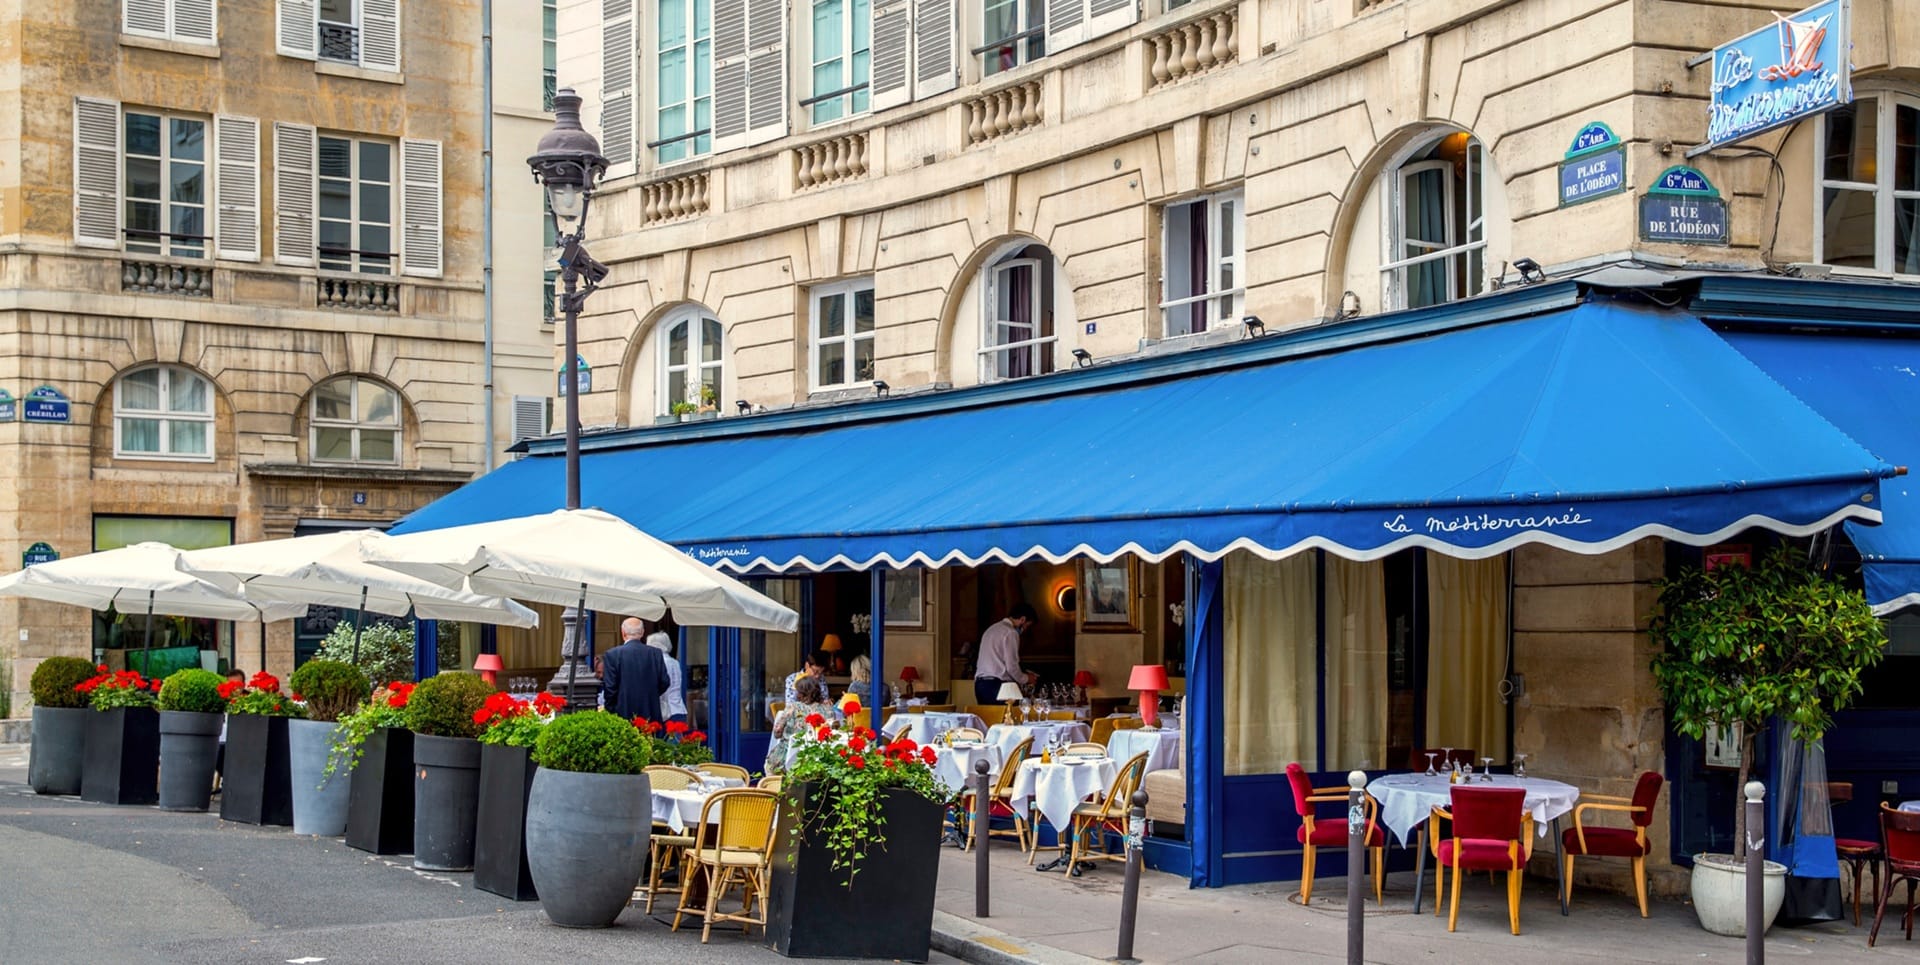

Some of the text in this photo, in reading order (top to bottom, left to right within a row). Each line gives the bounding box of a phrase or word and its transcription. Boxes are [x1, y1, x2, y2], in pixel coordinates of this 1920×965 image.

[1710, 47, 1753, 92] La
[1577, 160, 1607, 179] PLACE
[1566, 172, 1618, 197] DE L'ODÉON
[1670, 206, 1698, 219] RUE
[1649, 219, 1720, 235] DE L'ODÉON
[40, 403, 54, 411] RUE
[1384, 514, 1413, 533] La
